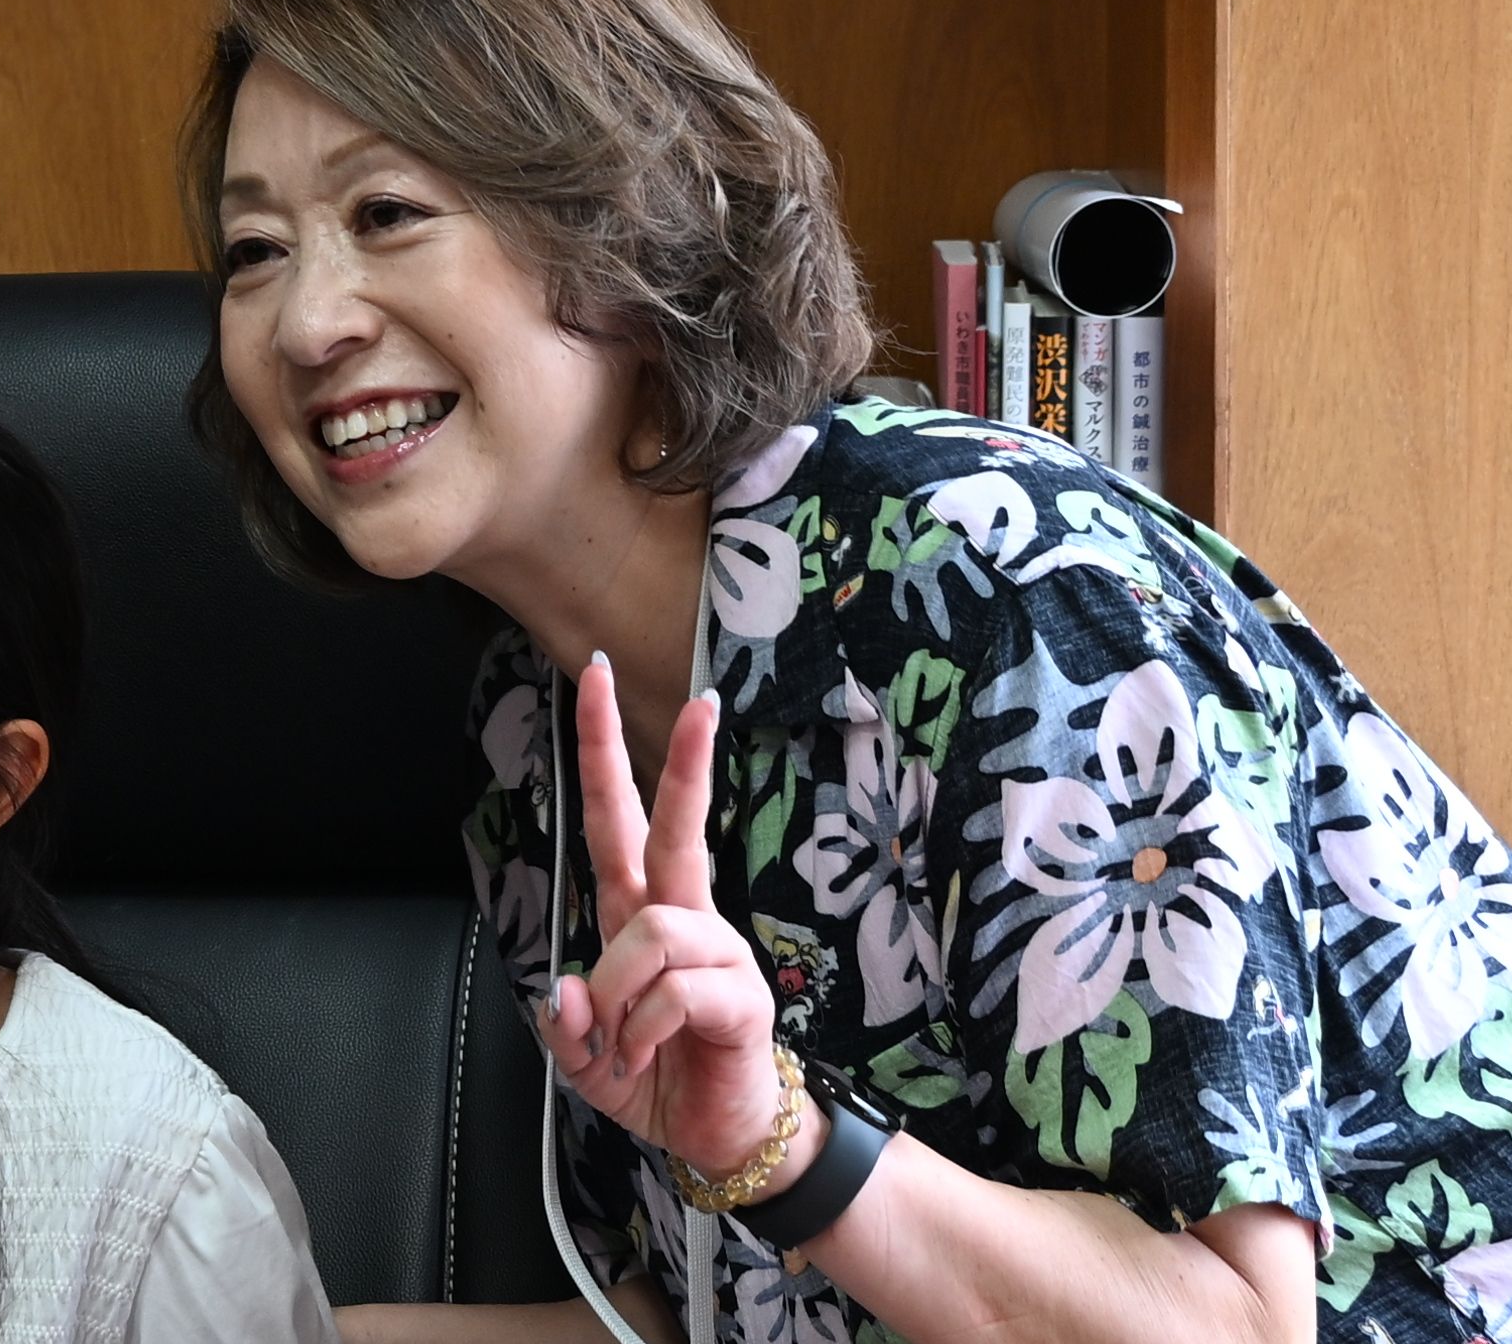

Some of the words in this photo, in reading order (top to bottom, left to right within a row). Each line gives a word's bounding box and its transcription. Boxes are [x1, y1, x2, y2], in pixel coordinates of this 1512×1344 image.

[1006, 327, 1025, 424] 原発難民の
[1093, 322, 1108, 361] マンガ
[1034, 333, 1068, 434] 渋沢栄
[1084, 400, 1104, 460] マルクス
